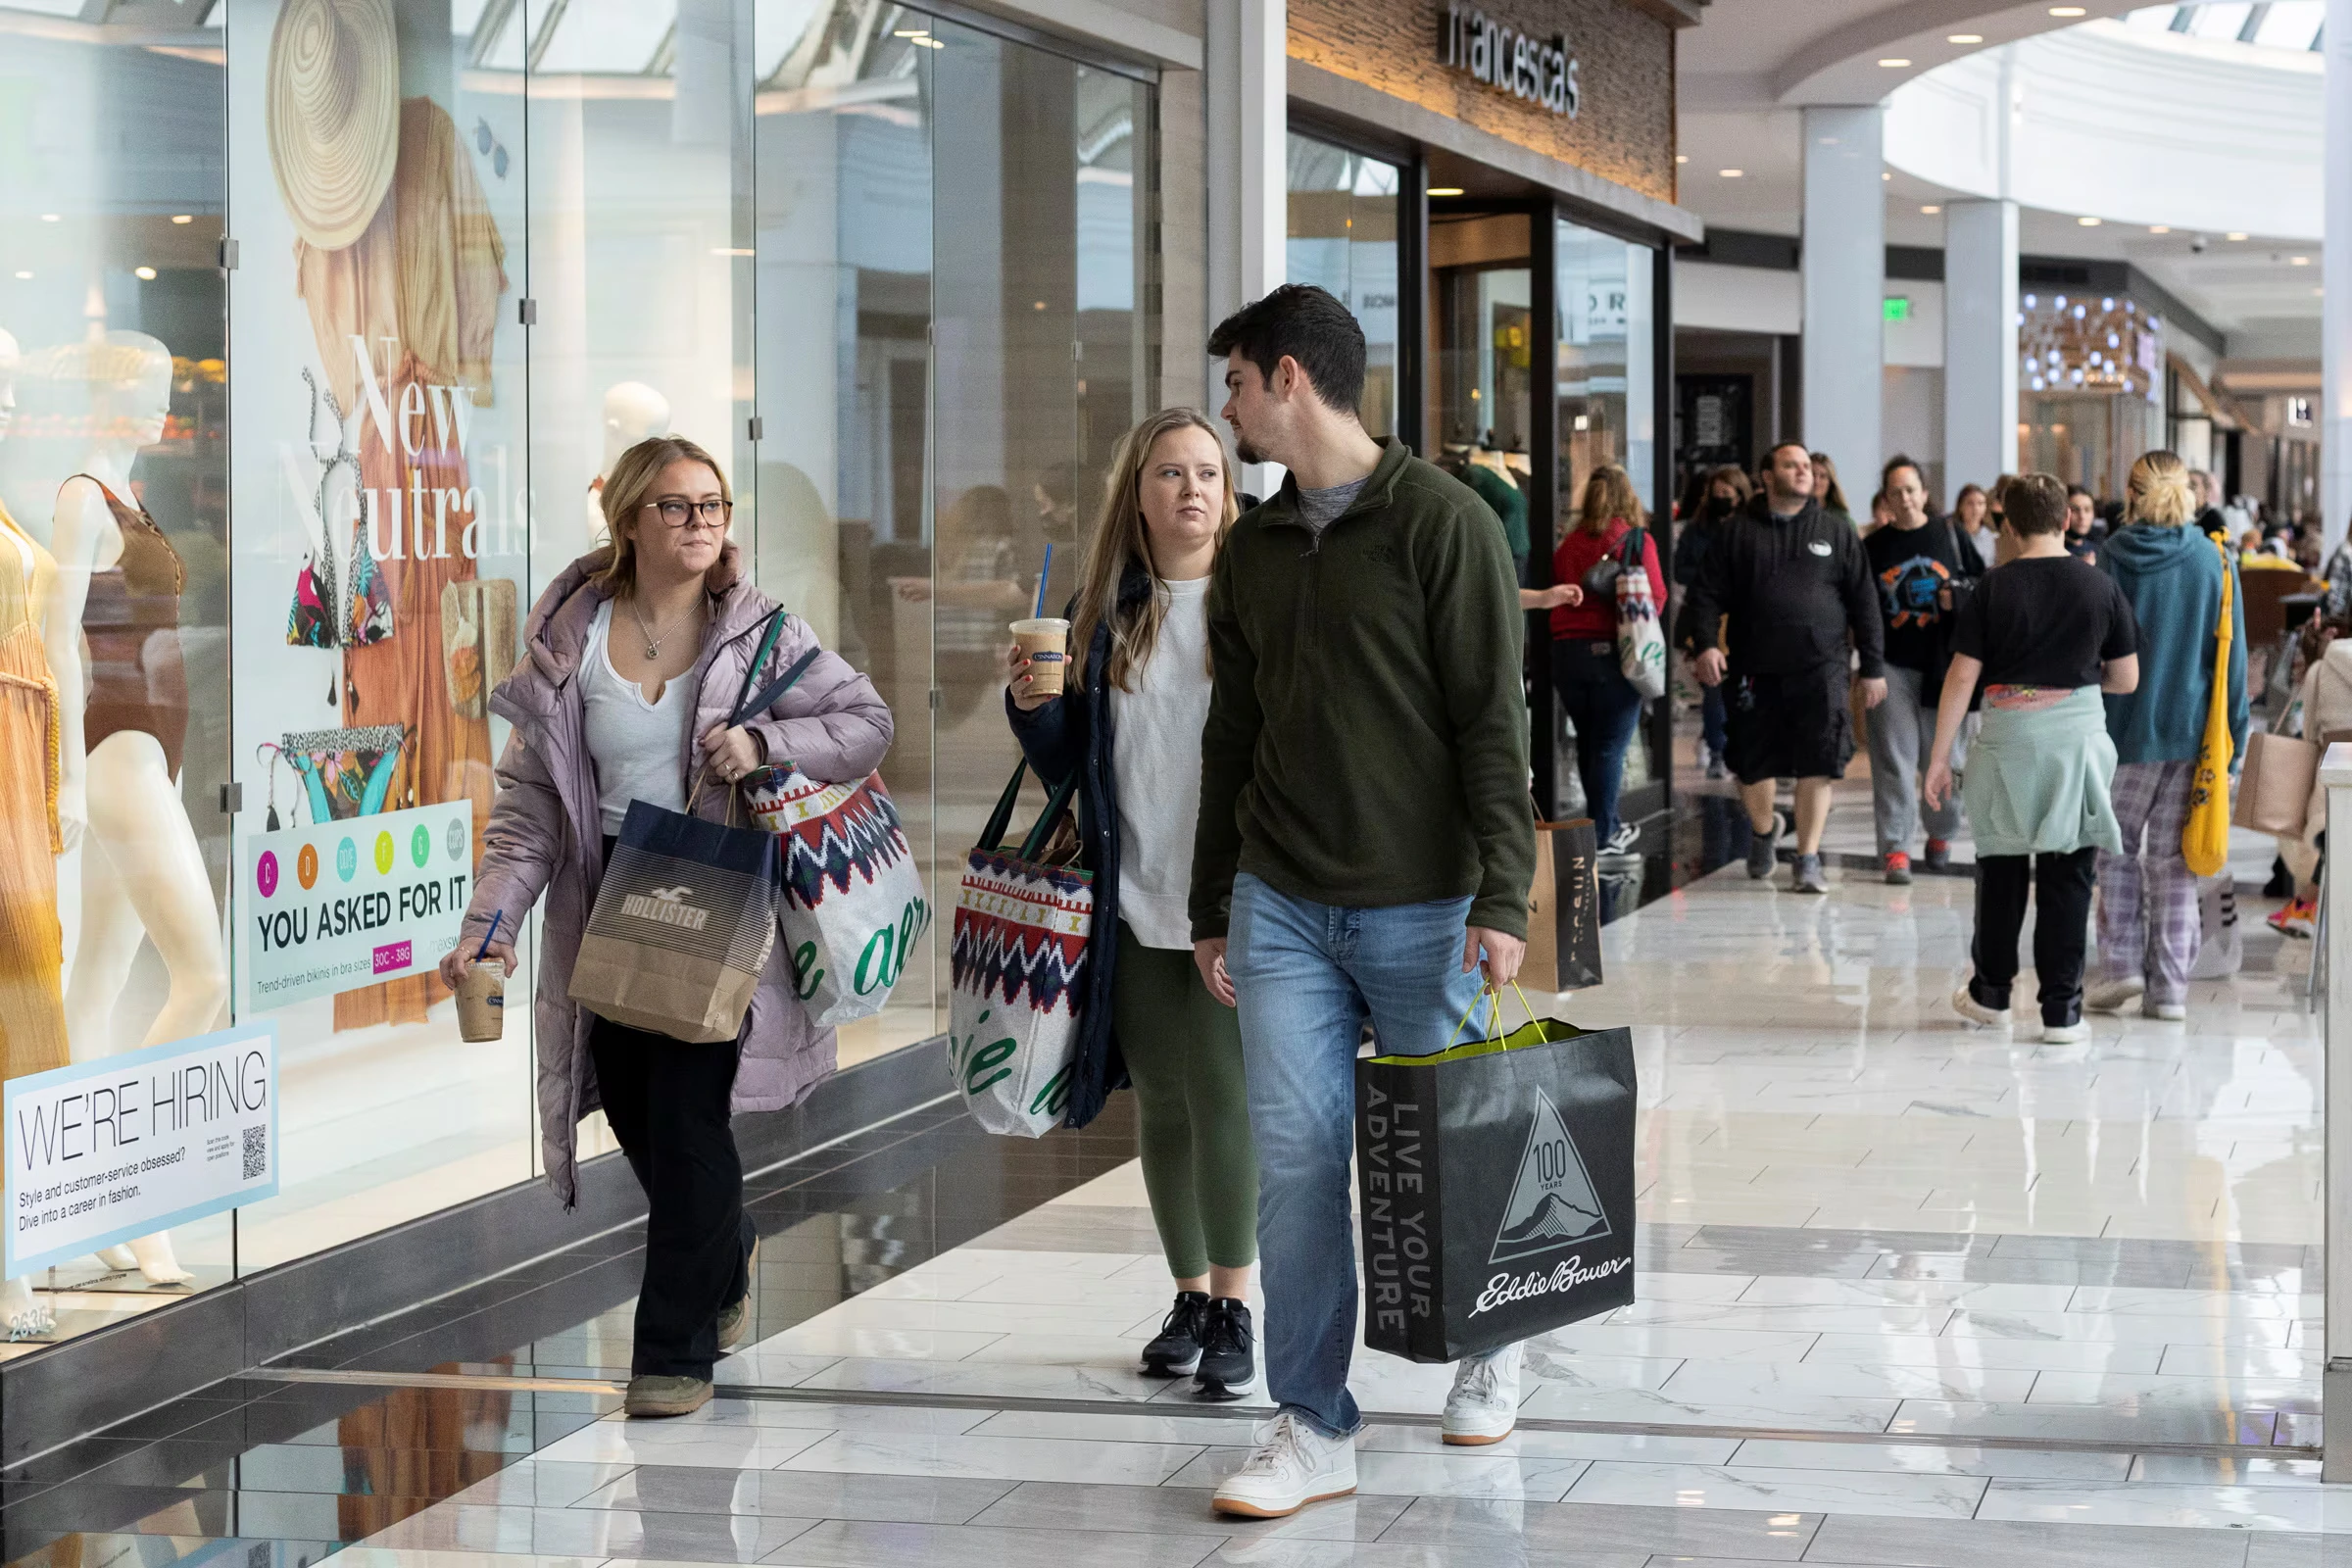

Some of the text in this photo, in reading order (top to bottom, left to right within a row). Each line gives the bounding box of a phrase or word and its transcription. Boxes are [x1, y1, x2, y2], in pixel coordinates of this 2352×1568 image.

[345, 334, 477, 459] New
[271, 442, 538, 564] Neutrals
[265, 862, 270, 884] C
[305, 856, 311, 876] D
[258, 875, 466, 952] YOU ASKED FOR IT
[620, 894, 708, 931] HOLLISTER
[258, 974, 306, 994] Trend-driven
[307, 965, 330, 983] bikinis
[331, 963, 339, 976] in
[340, 961, 353, 975] bra
[354, 957, 371, 971] sizes
[374, 951, 390, 967] 30C
[395, 947, 411, 962] 38G
[430, 935, 460, 953] maxsw
[19, 1051, 267, 1171] WE'RE HIRING
[19, 1147, 186, 1209] Style and customer-service obsessed?
[1533, 1139, 1566, 1183] 100
[1541, 1180, 1562, 1192] YEARS
[19, 1185, 141, 1232] Dive into a career in fashion.
[1367, 1081, 1405, 1331] ADVENTURE
[1394, 1103, 1431, 1318] LIVE YOUR
[1468, 1254, 1632, 1319] Eddie Bauer
